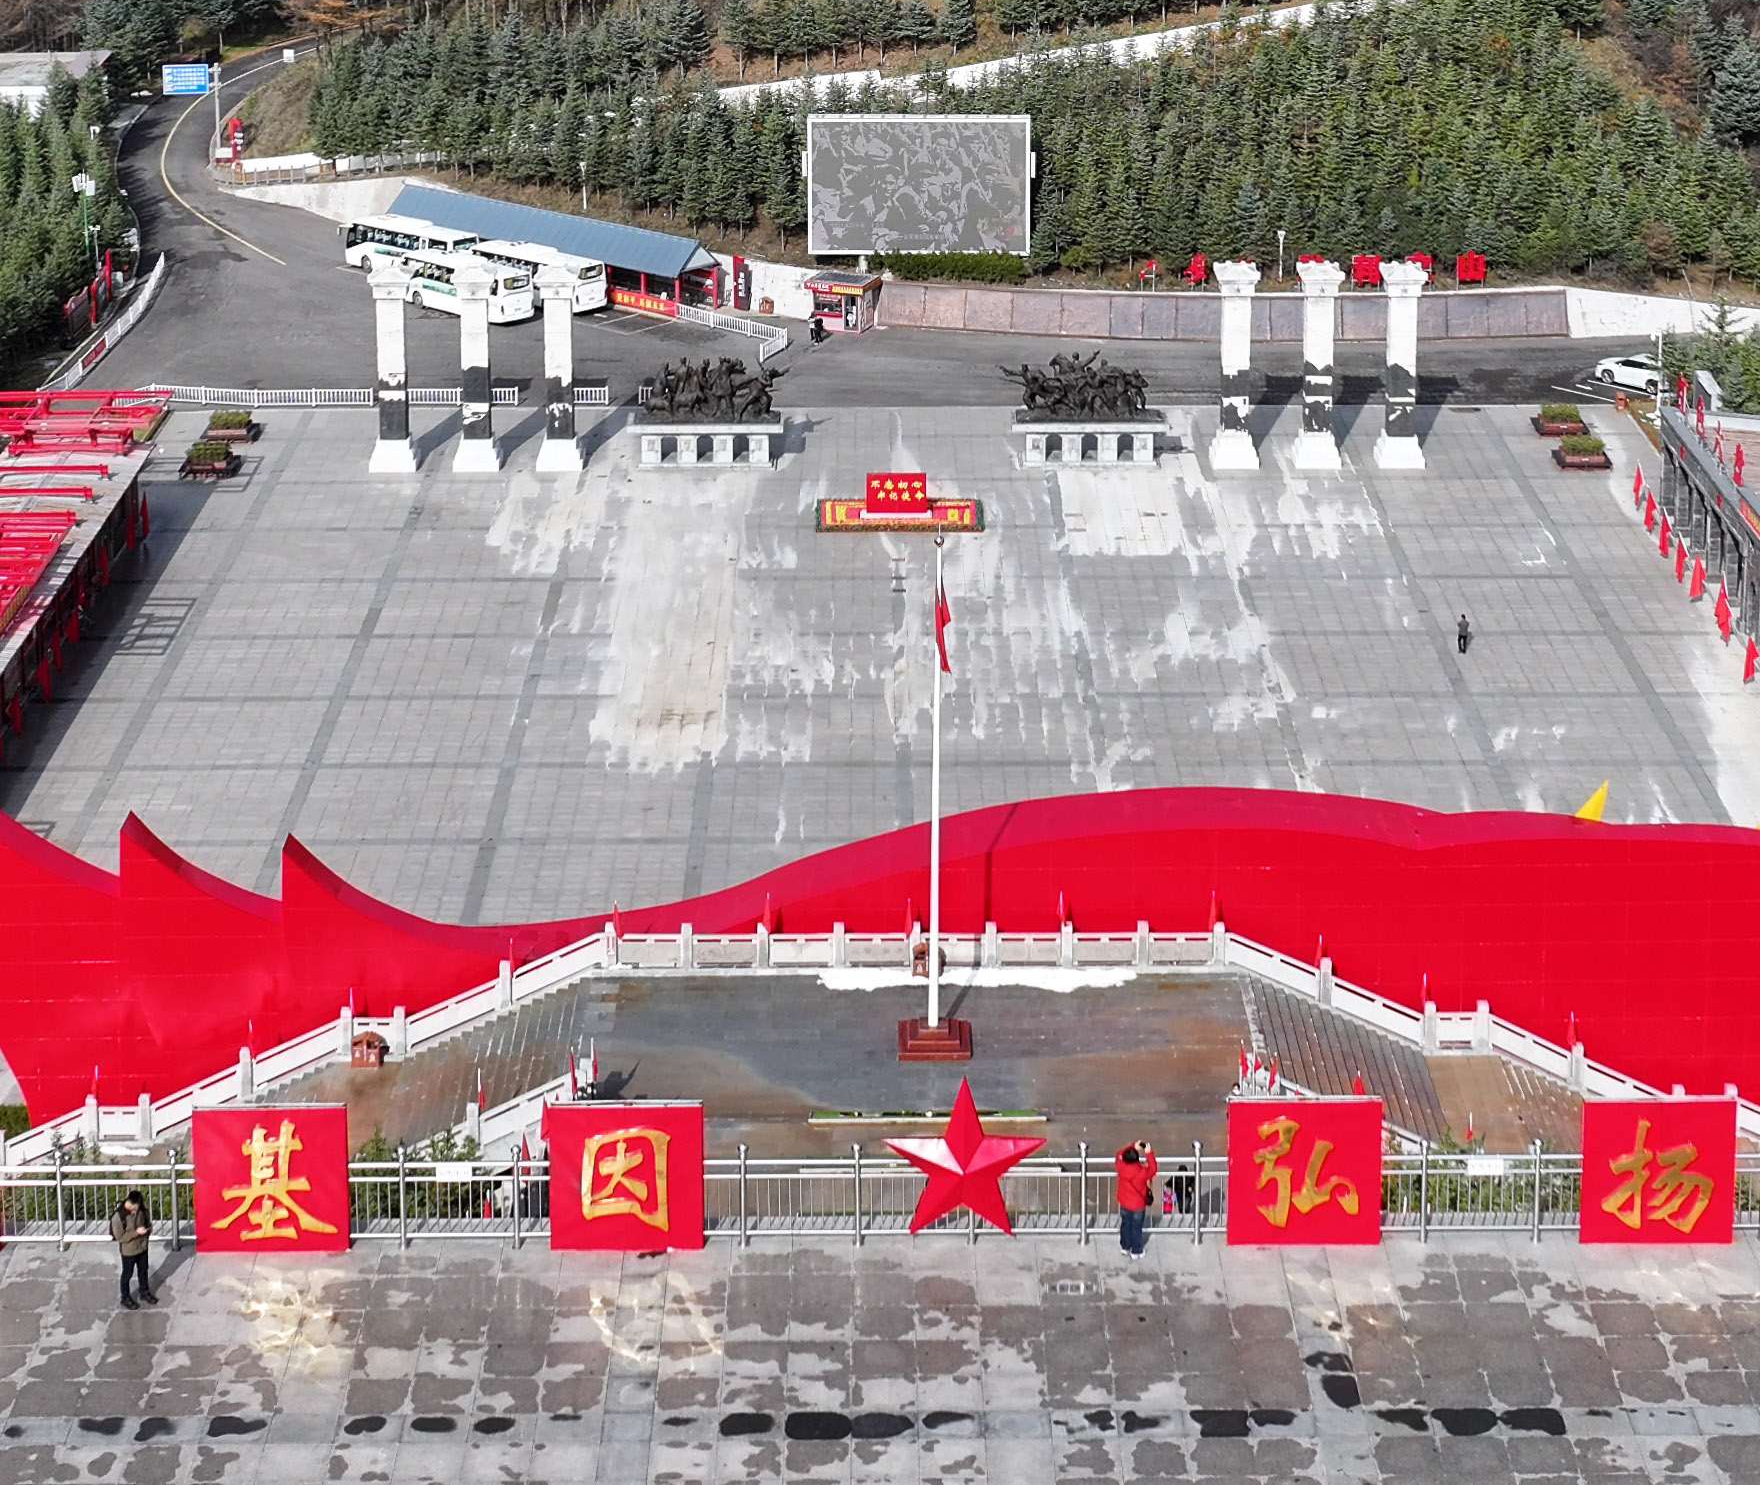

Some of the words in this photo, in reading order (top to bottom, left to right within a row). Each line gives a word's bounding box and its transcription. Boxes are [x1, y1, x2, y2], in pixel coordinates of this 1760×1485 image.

[870, 478, 923, 490] 不忘初心
[877, 490, 925, 502] 牢记使命
